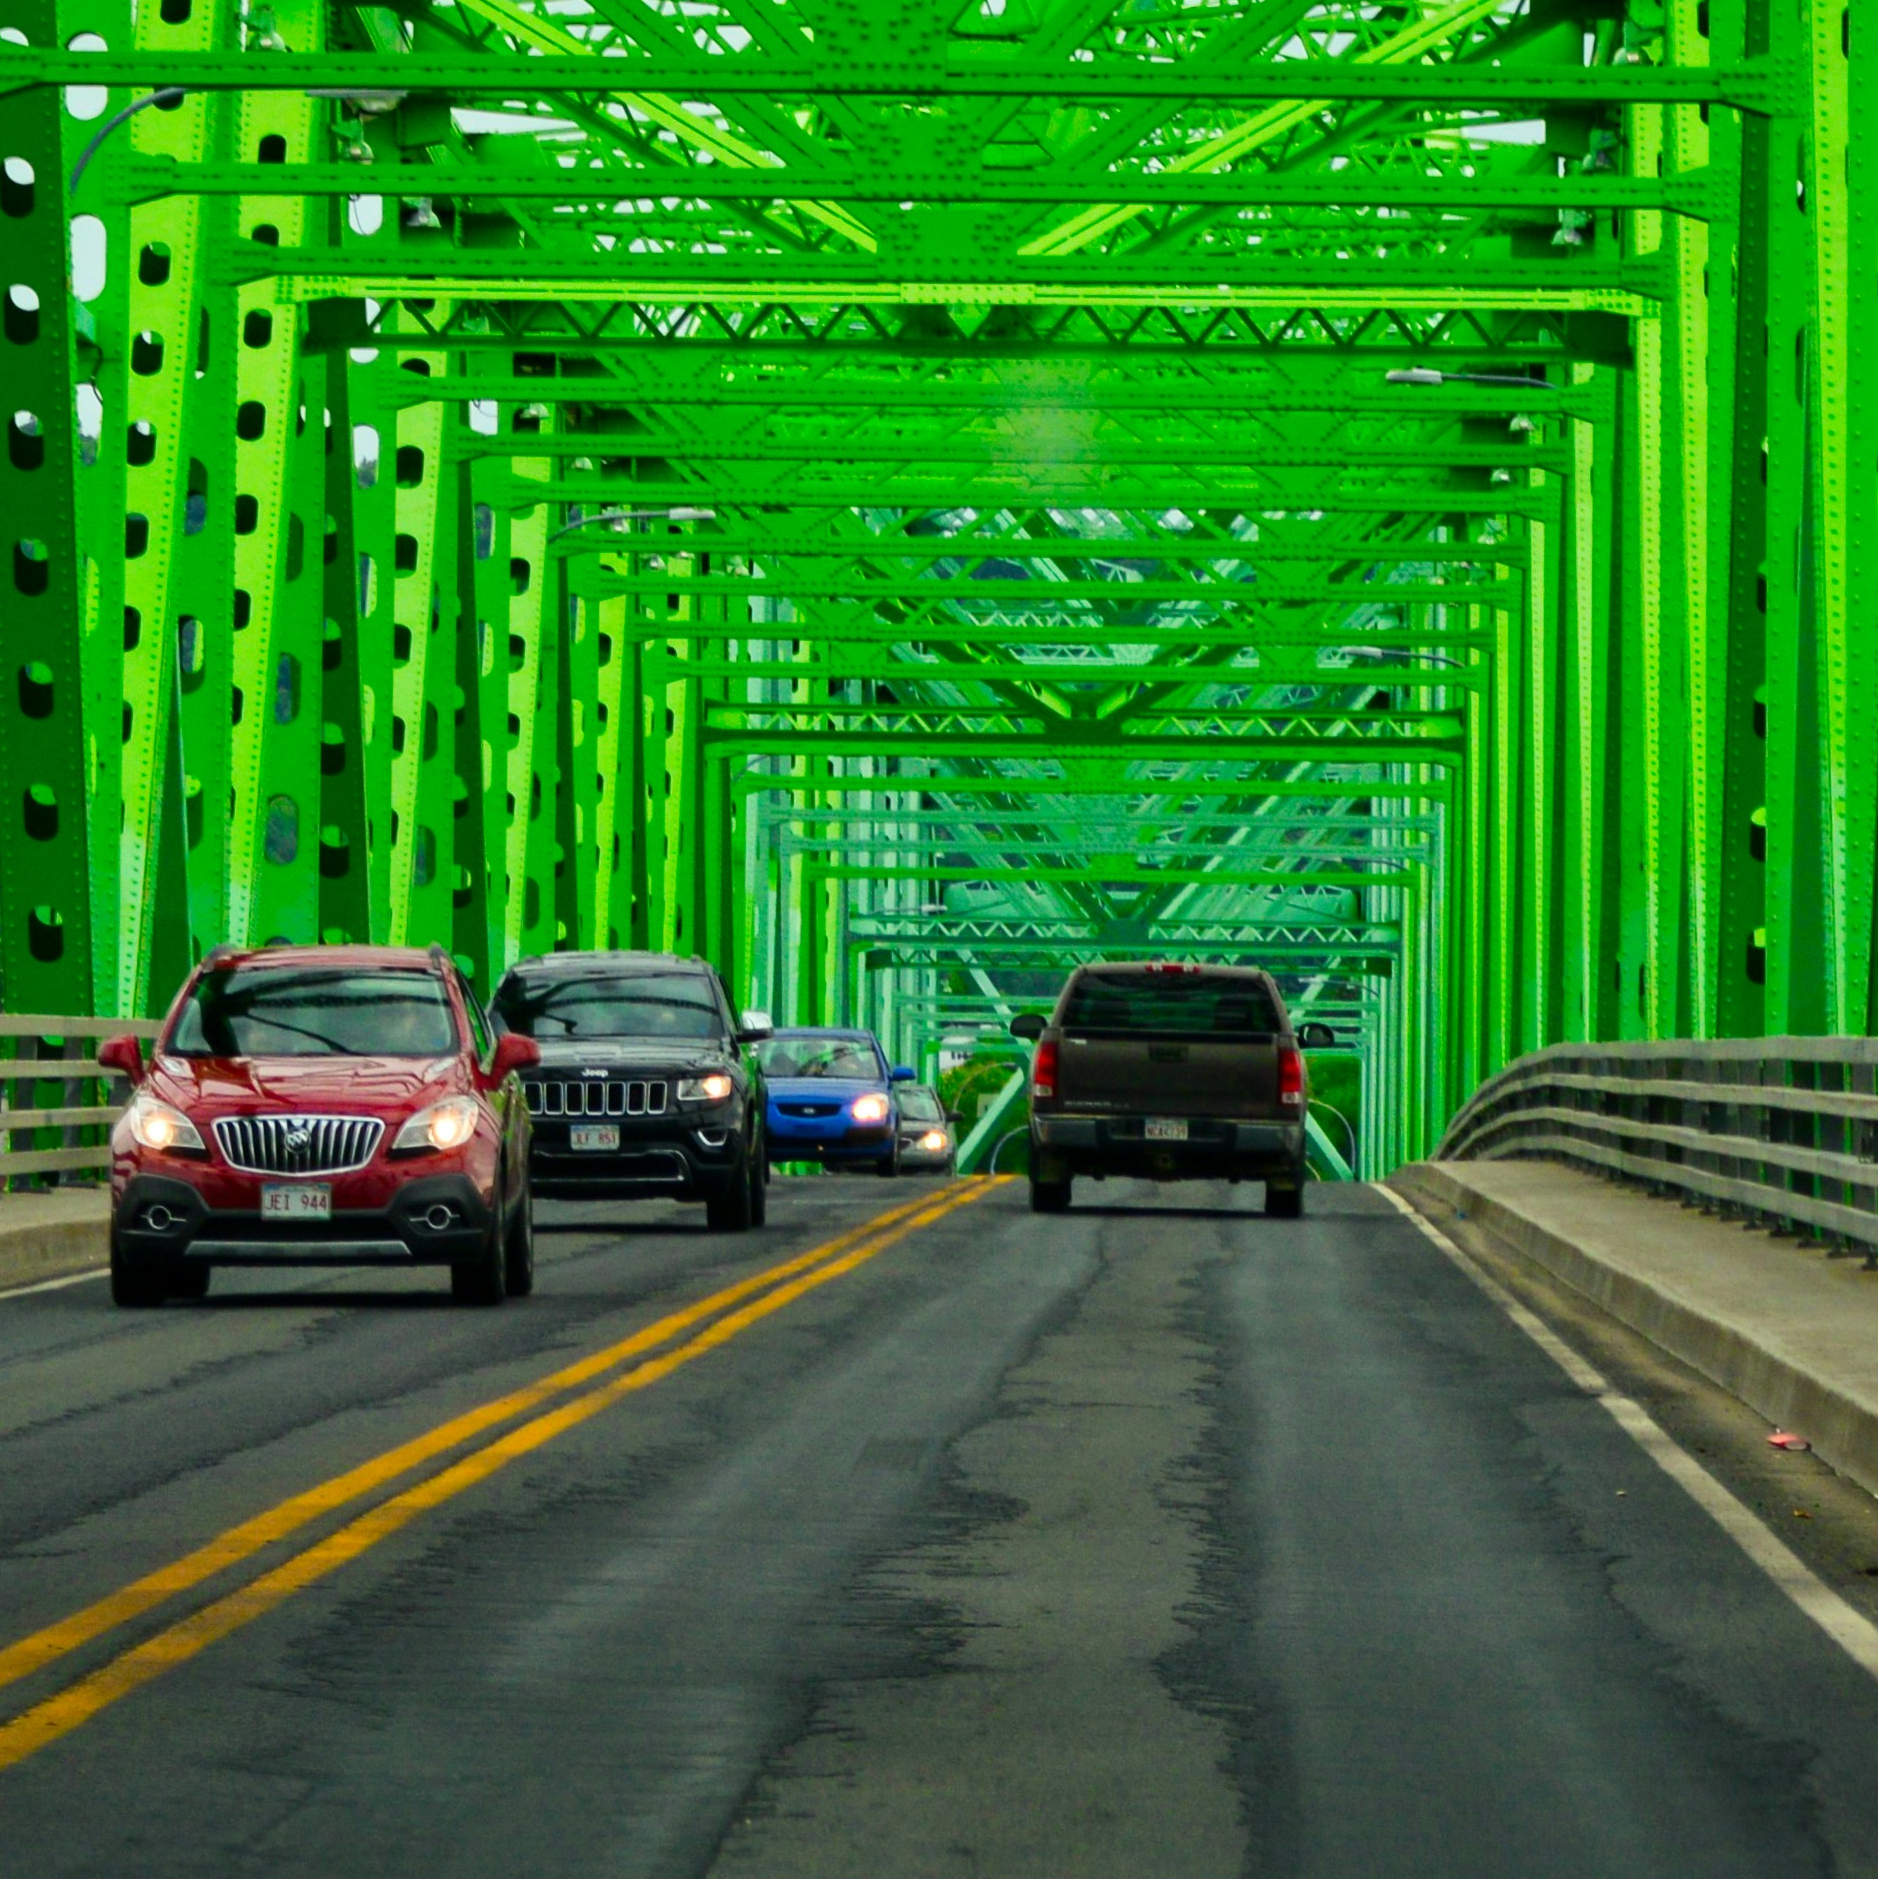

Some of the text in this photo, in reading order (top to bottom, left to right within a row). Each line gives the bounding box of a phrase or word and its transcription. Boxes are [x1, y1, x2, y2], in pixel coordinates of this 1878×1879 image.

[581, 1068, 609, 1078] Jeep
[264, 1193, 327, 1211] JEI 944
